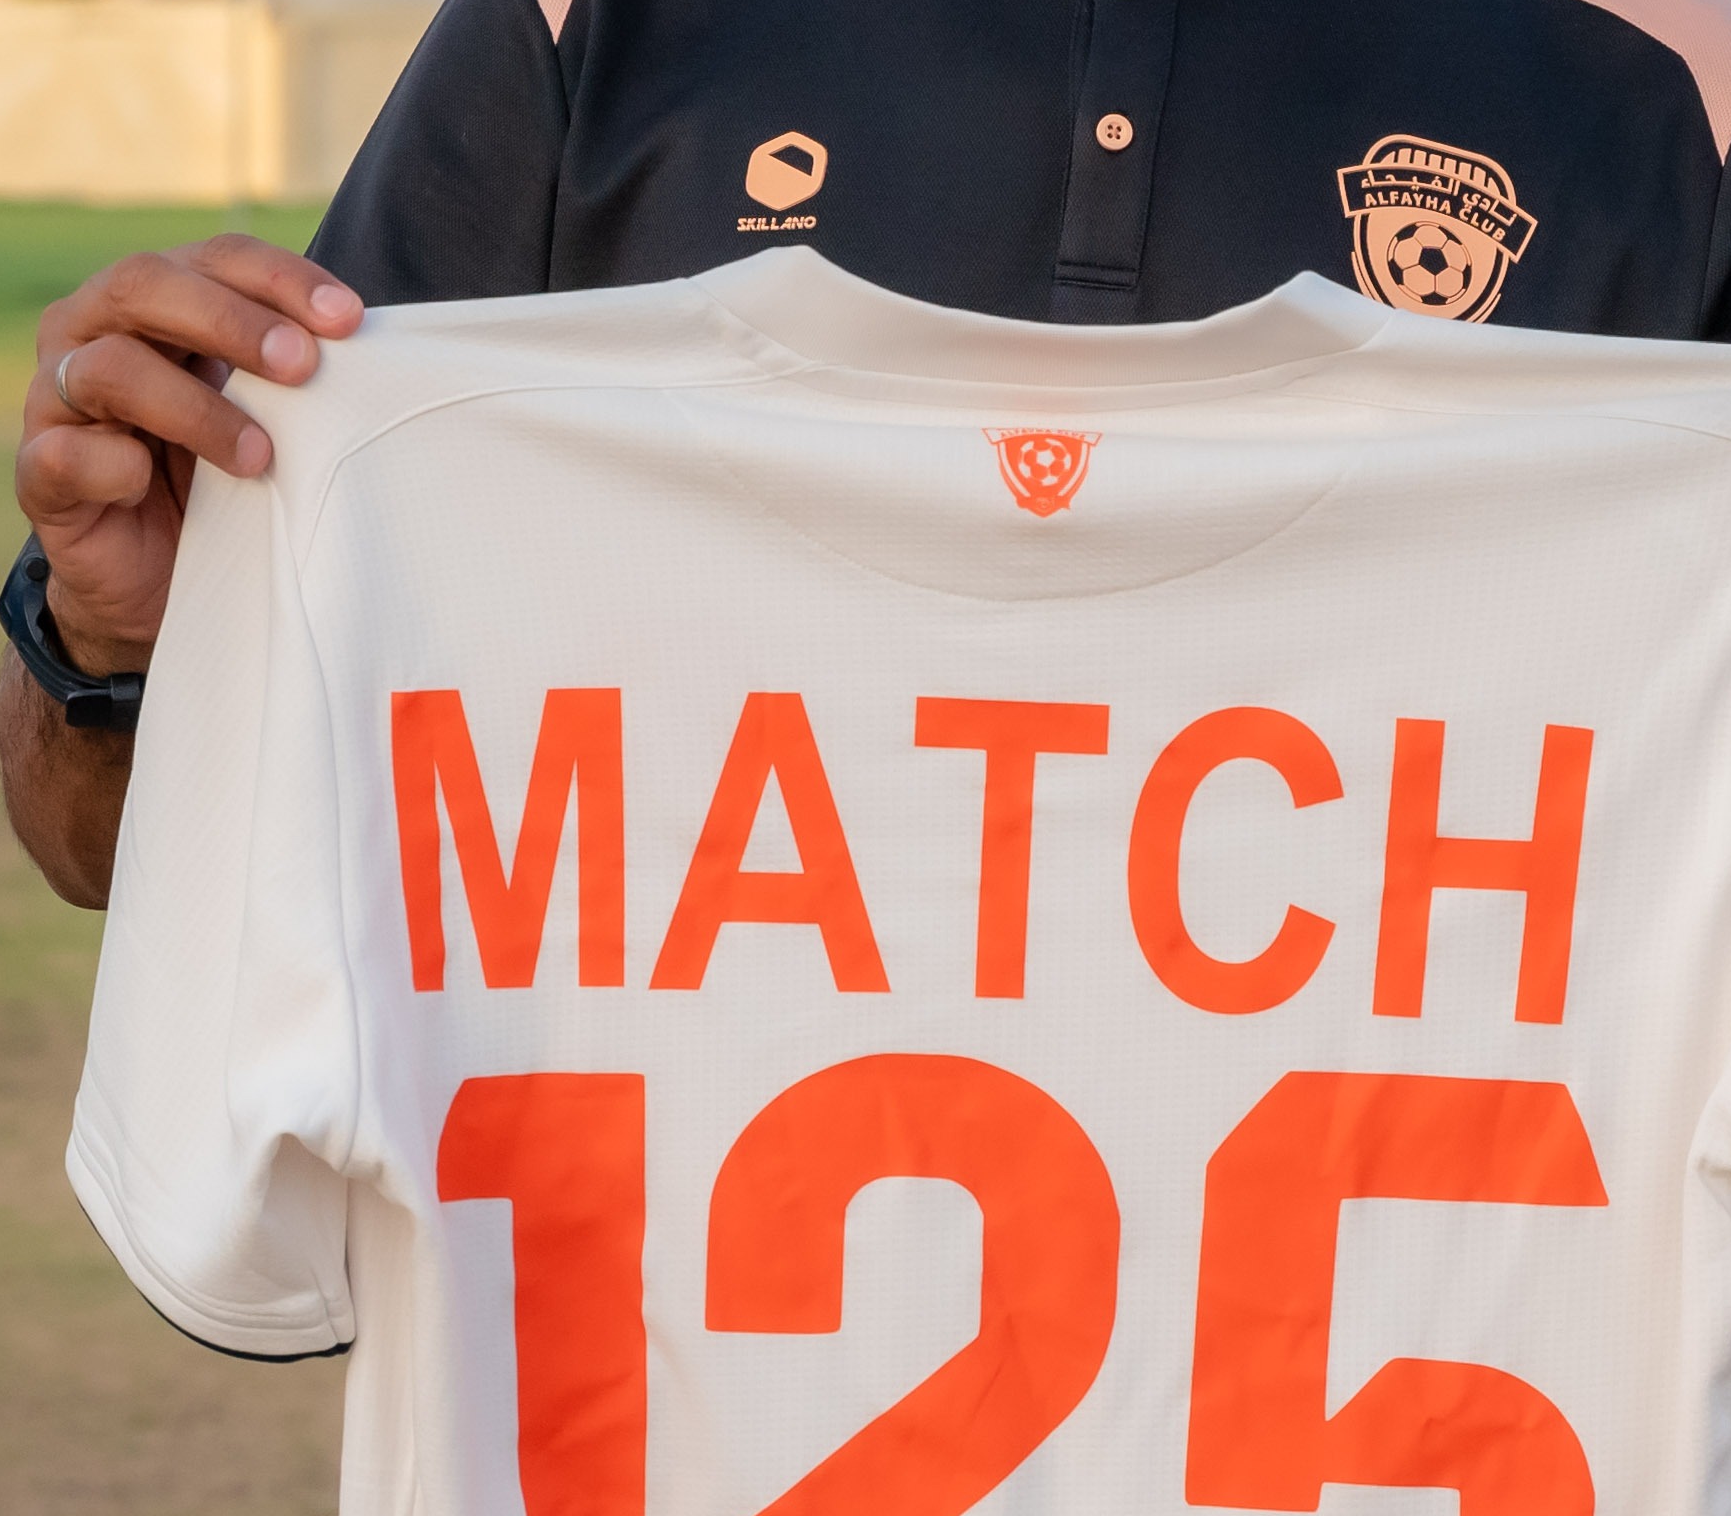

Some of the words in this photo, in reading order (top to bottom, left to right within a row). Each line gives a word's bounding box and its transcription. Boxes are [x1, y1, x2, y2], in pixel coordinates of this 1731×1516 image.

[1361, 169, 1461, 196] الفيحاء
[737, 215, 817, 232] SKILLANO
[1364, 190, 1452, 215] ALFAYHA
[1458, 207, 1506, 242] CLUB
[1462, 192, 1518, 227] نادي
[390, 687, 1594, 1025] MATCH
